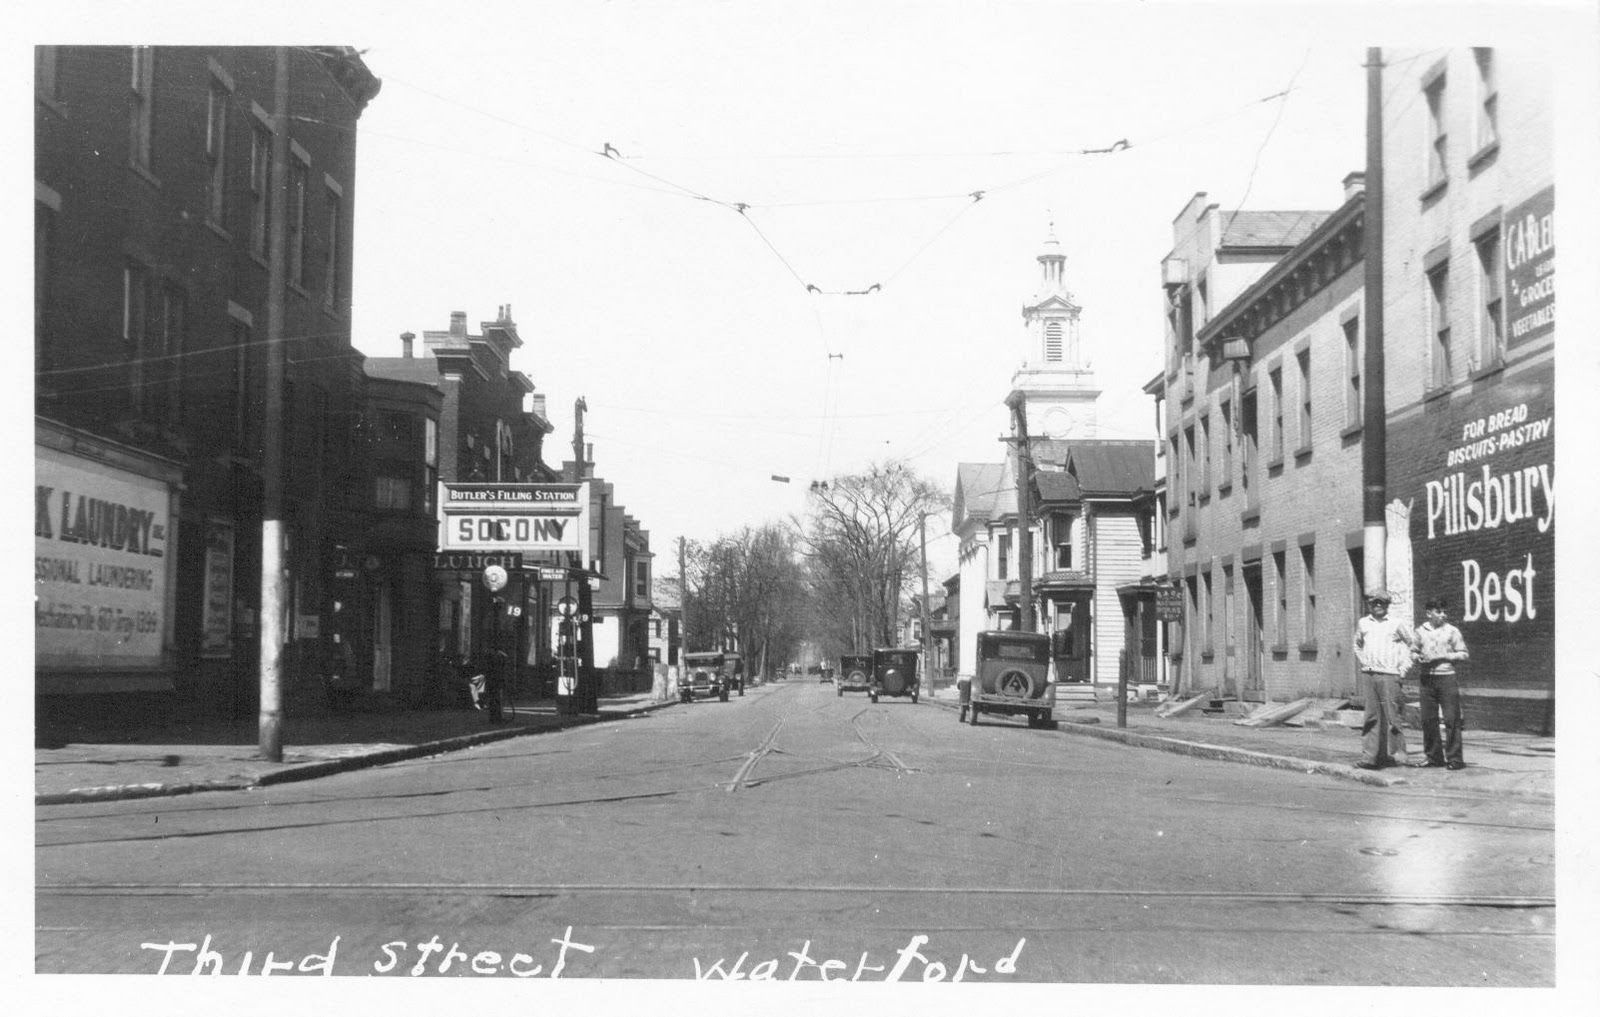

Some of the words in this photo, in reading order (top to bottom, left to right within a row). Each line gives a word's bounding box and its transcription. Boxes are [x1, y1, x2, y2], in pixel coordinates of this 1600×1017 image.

[1463, 418, 1486, 441] FOR
[1488, 403, 1528, 433] BREAD
[451, 490, 496, 500] BUTLER'S
[498, 490, 533, 500] FILLING
[535, 490, 575, 500] STATION
[1425, 464, 1555, 539] Pillsbury
[60, 491, 154, 556] LAUNDRY
[459, 518, 569, 542] SOCONY
[433, 555, 516, 569] LUNCH
[1462, 552, 1537, 623] Best
